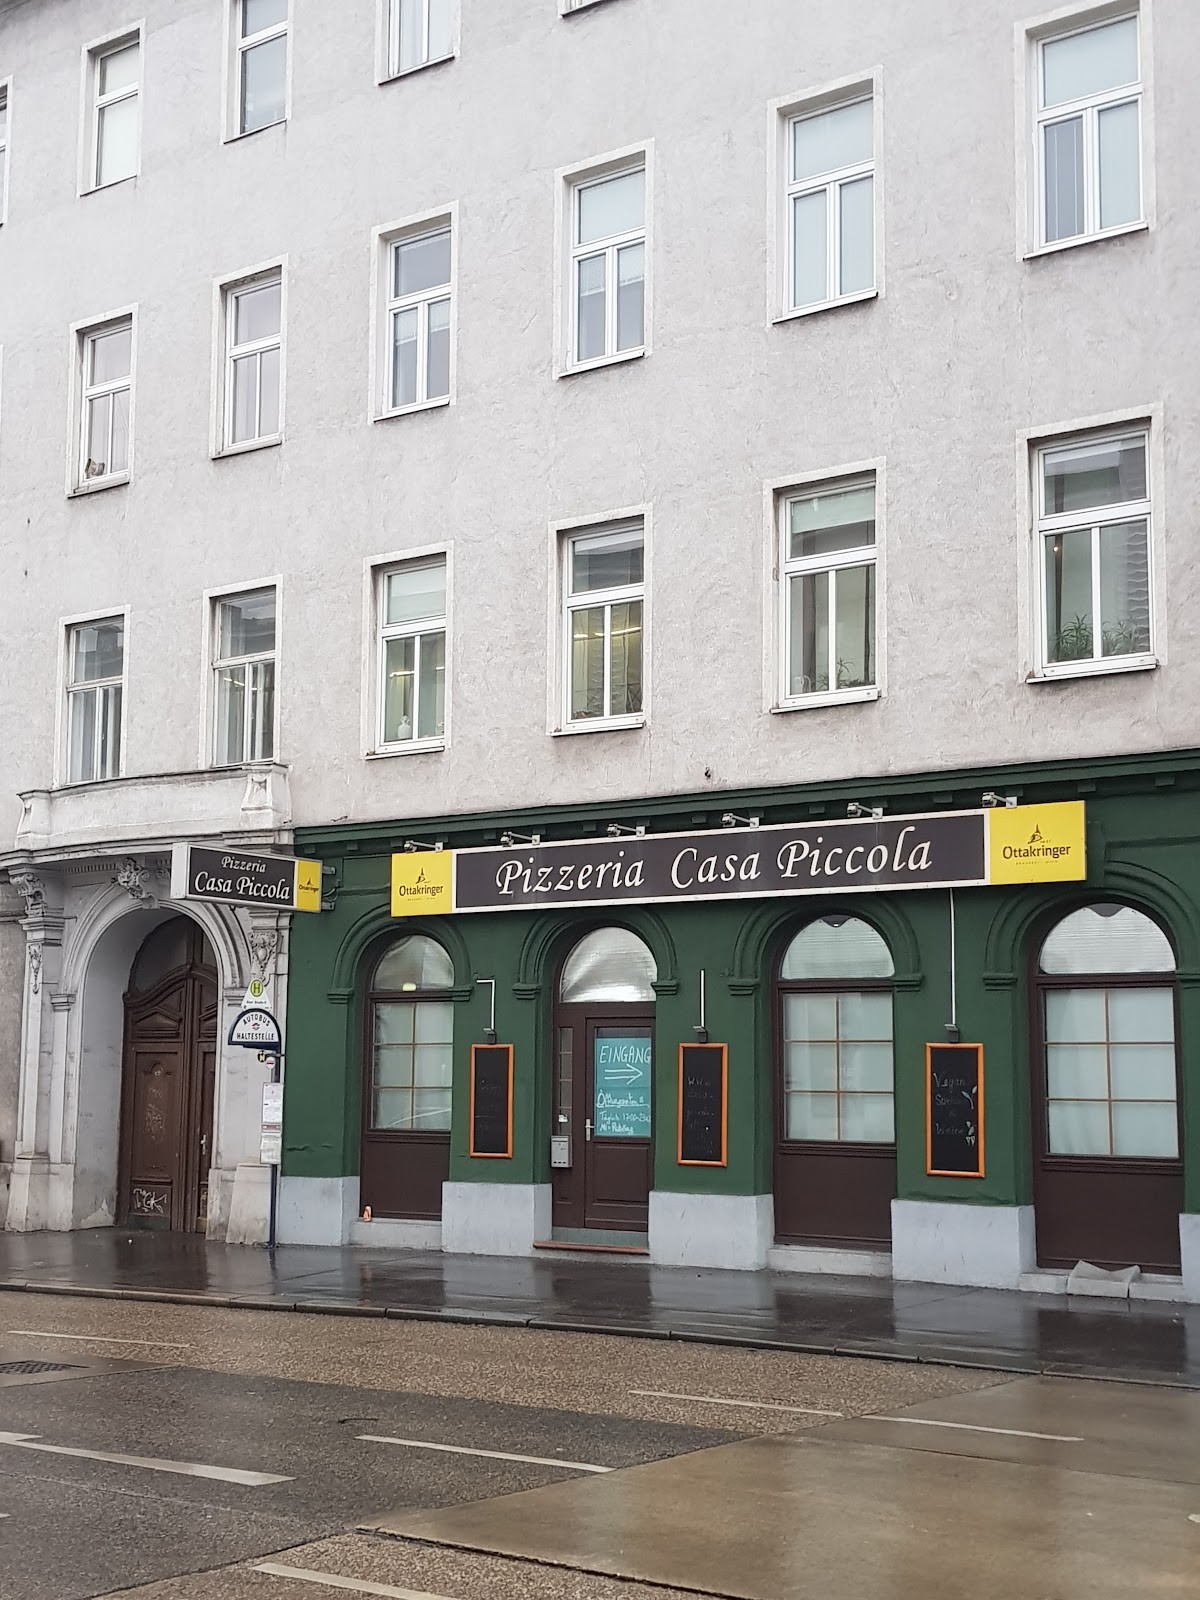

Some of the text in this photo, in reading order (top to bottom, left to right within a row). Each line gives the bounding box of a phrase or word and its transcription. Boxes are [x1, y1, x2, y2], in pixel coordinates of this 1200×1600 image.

[1002, 845, 1071, 860] Ottakringer
[221, 856, 266, 873] Pizzeria
[496, 826, 932, 896] Pizzeria Casa Piccola
[194, 871, 290, 900] Casa Piccola
[399, 885, 444, 897] Ottakringer
[253, 982, 261, 994] H
[242, 1013, 271, 1027] AUTOBUS
[236, 1031, 275, 1041] HALTESTELLE
[600, 1045, 651, 1064] EINGANG
